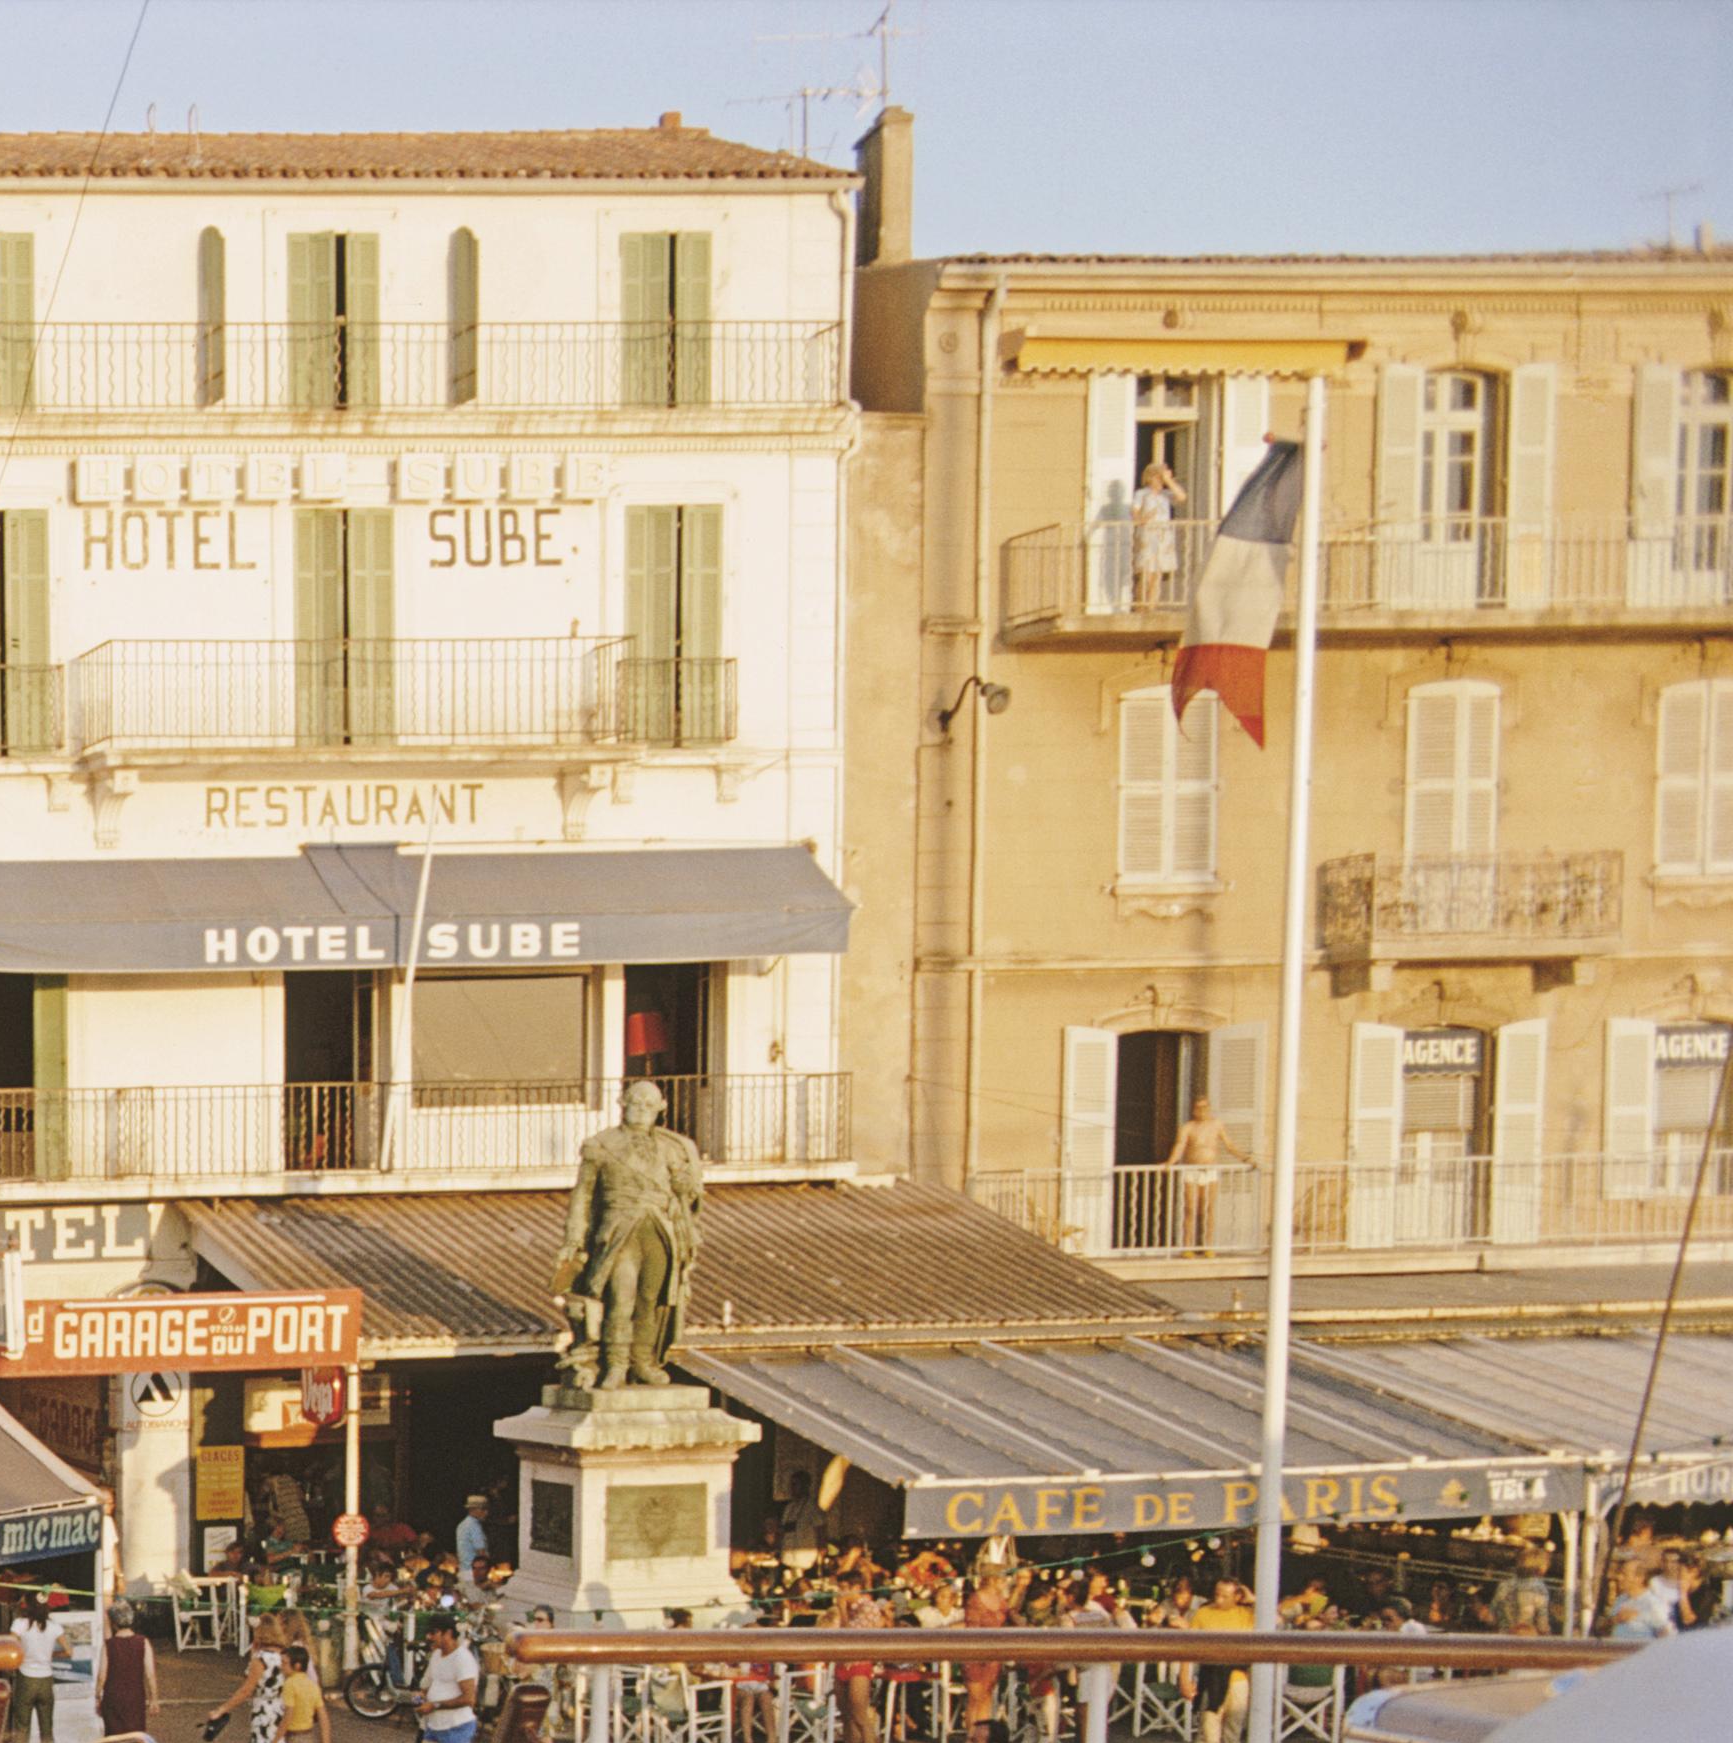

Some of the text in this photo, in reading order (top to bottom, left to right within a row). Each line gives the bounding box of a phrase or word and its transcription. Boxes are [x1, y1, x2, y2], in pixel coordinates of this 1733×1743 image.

[82, 507, 564, 571] HOTEL SUBE
[204, 783, 484, 829] RESTAURANT
[204, 921, 583, 963] HOTEL SUBE
[1403, 1037, 1478, 1067] AGENCE
[1656, 1032, 1728, 1062] AGENCE
[53, 1308, 209, 1360] GARAGE
[211, 1335, 244, 1355] DU
[247, 1304, 350, 1355] PORT
[1, 1508, 101, 1556] micmac
[945, 1484, 1106, 1535] CAFÉ
[1135, 1493, 1196, 1526] DE
